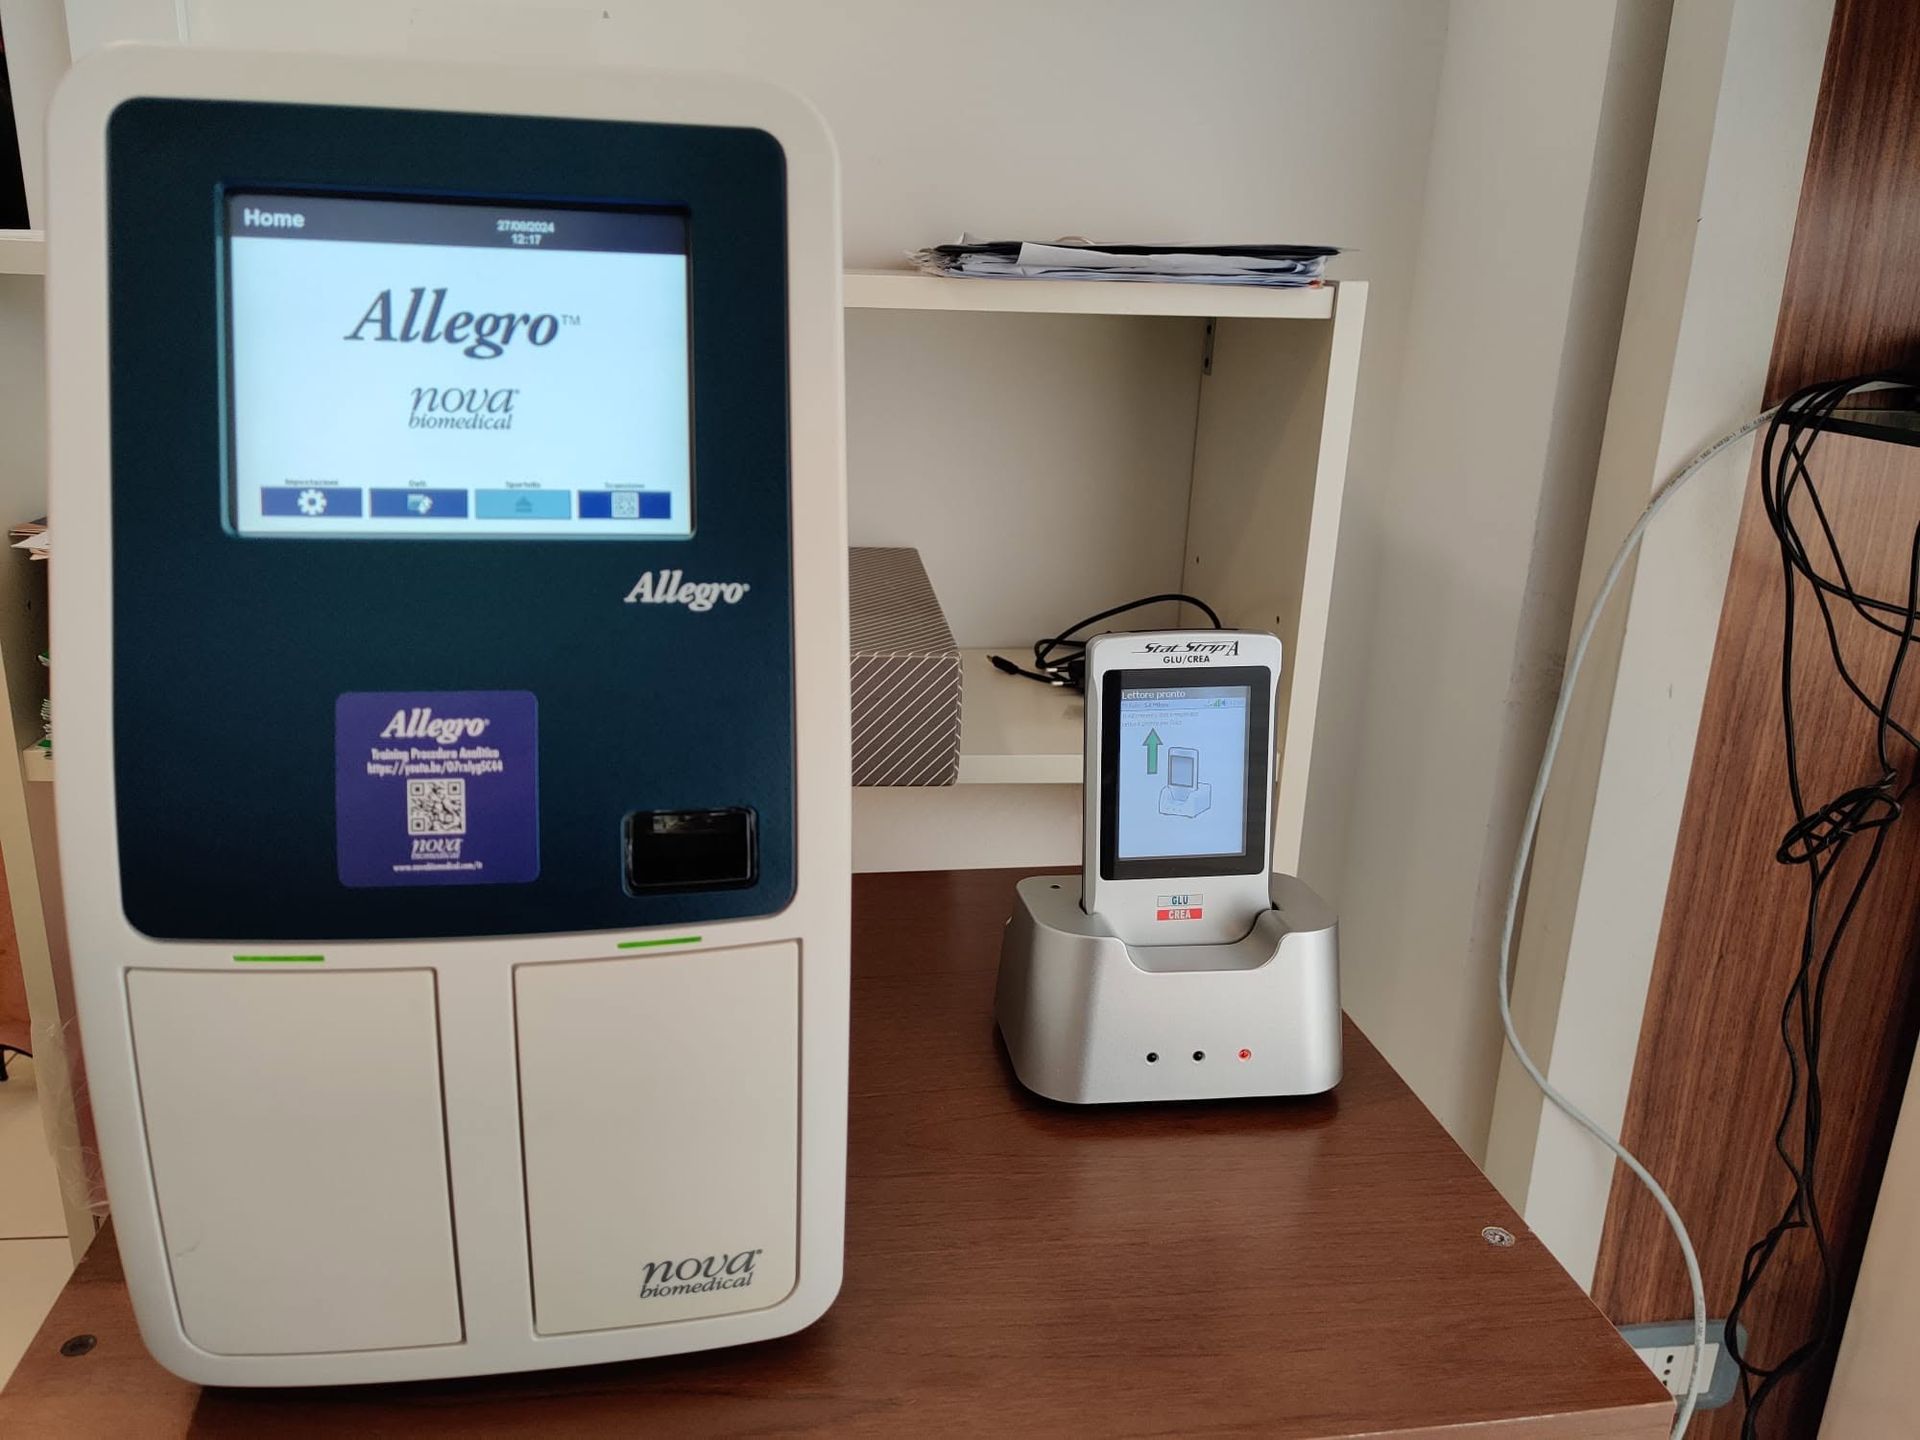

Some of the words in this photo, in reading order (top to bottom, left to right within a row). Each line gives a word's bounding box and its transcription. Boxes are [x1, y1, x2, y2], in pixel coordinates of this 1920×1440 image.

[243, 207, 305, 228] Home
[511, 233, 542, 245] 12:17
[344, 287, 559, 359] Allegro
[410, 387, 515, 413] nova
[408, 411, 513, 430] biomedical
[623, 569, 747, 612] Allegro
[1163, 655, 1210, 664] GLU/CREA
[1121, 691, 1155, 700] Lettore
[1156, 690, 1186, 700] pronto
[379, 708, 489, 743] Allegro
[411, 838, 463, 852] nova
[1171, 895, 1189, 905] GLU
[1168, 909, 1192, 920] CREA
[642, 1249, 757, 1283] nova
[640, 1272, 753, 1299] biomedical
